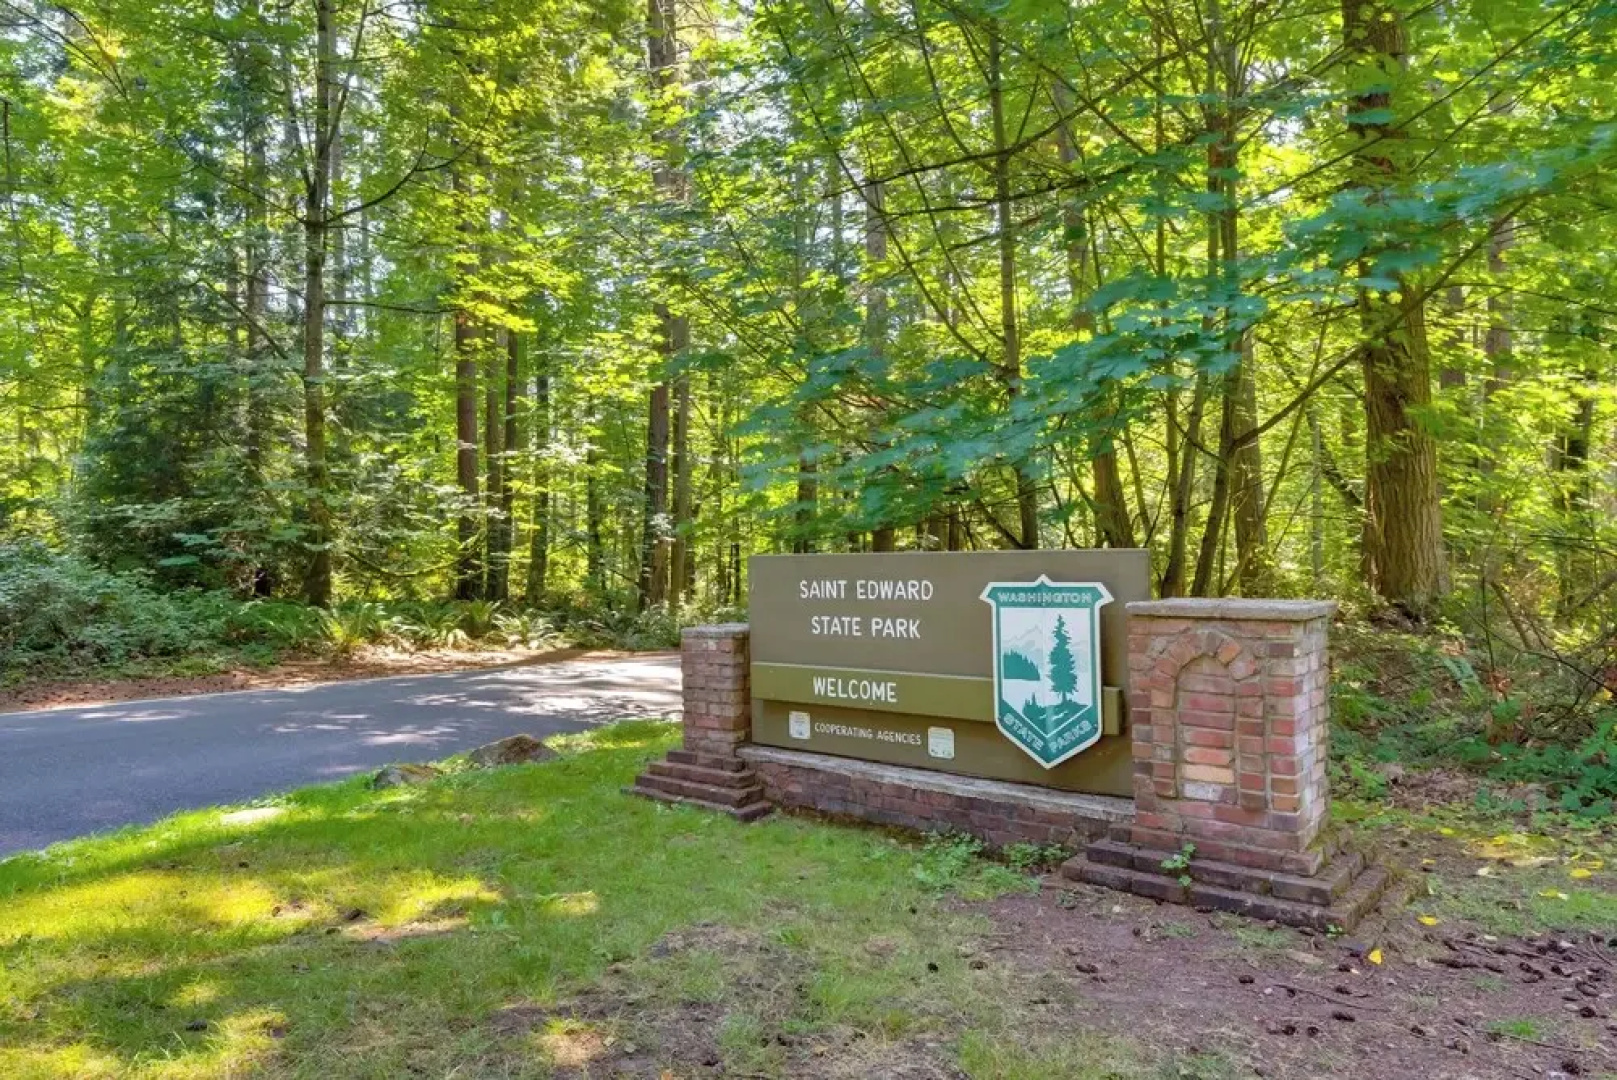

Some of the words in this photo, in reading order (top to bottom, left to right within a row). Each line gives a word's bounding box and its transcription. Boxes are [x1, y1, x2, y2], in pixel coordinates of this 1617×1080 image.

[799, 579, 848, 599] SAINT
[856, 580, 934, 601] EDWARD
[997, 592, 1093, 604] WASHINGTON
[811, 616, 862, 636] STATE
[871, 618, 921, 639] PARK
[813, 676, 898, 703] WELCOME
[814, 722, 874, 740] COOPERATING
[877, 730, 922, 746] AGENCIES
[1003, 712, 1044, 751] STATE
